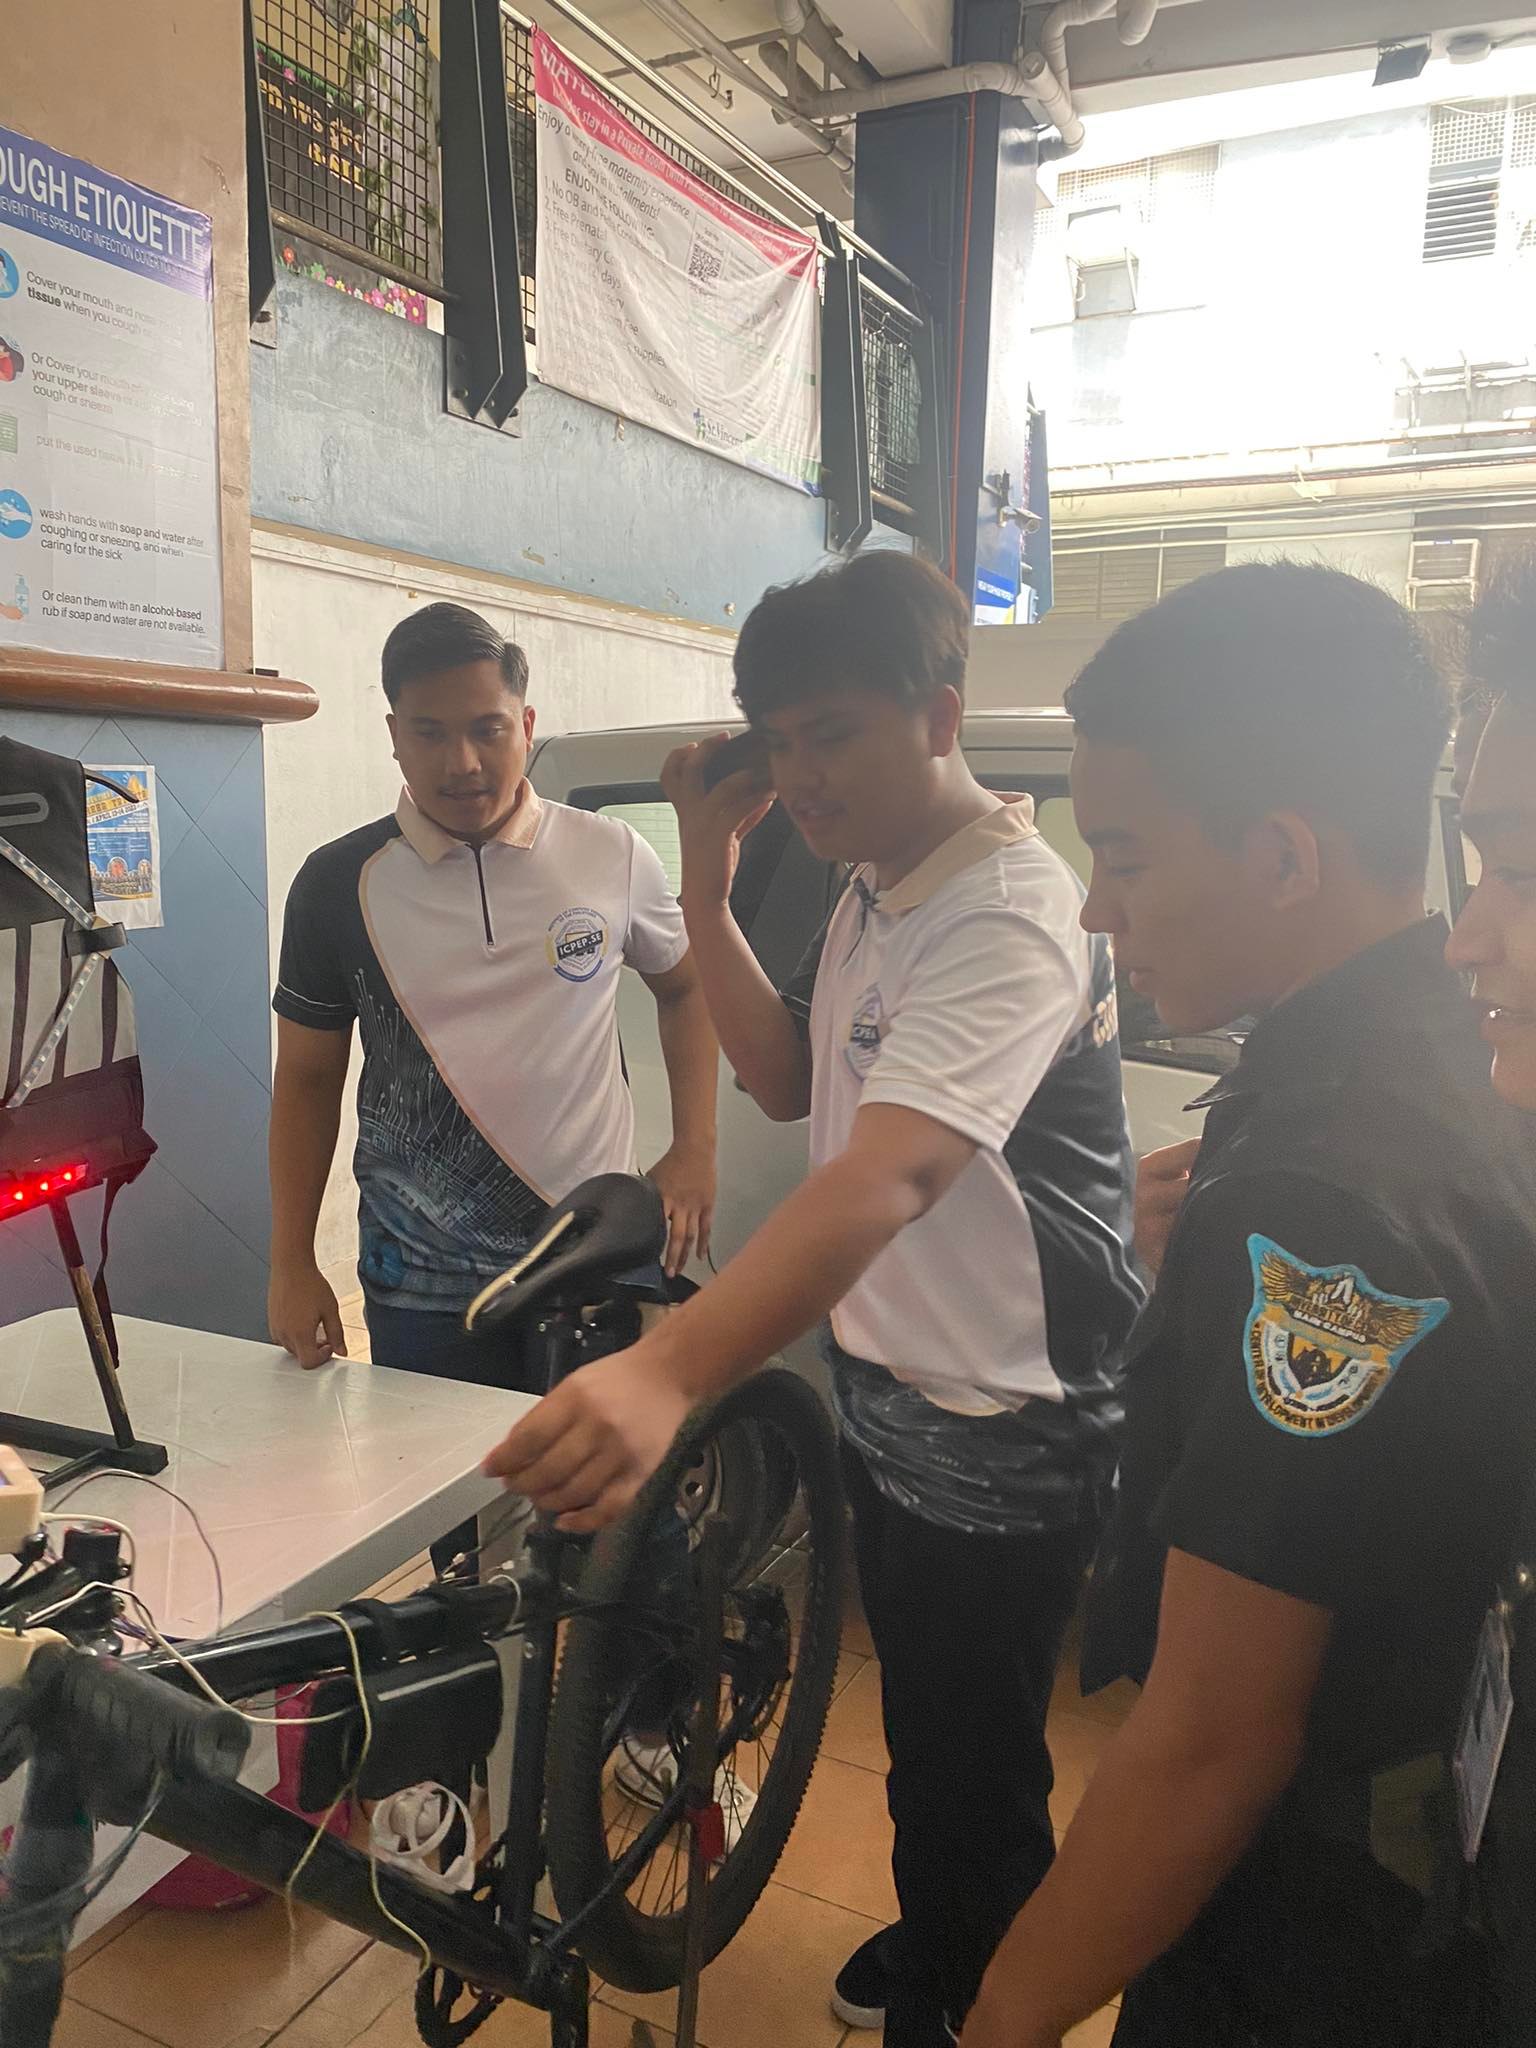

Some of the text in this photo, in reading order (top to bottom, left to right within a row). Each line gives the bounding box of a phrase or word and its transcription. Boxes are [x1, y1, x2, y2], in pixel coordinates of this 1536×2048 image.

[538, 104, 564, 134] Enjoy
[74, 175, 205, 271] ETIQUETTE
[27, 271, 57, 291] Cover
[58, 283, 81, 299] your
[82, 290, 114, 312] mouth
[27, 287, 62, 307] tissue
[64, 300, 91, 317] when
[92, 311, 111, 324] you
[31, 352, 44, 365] Or
[46, 356, 75, 374] Cover
[31, 369, 56, 384] your
[57, 375, 88, 393] upper
[33, 385, 66, 402] cough
[40, 508, 66, 522] wash
[68, 511, 97, 528] hands
[119, 523, 142, 537] soap
[144, 526, 160, 540] and
[40, 523, 87, 542] coughing
[88, 533, 98, 543] or
[41, 538, 123, 561] caring for the sick
[42, 590, 201, 621] Or clean them with an alcohol-based
[42, 605, 60, 617] rub
[68, 610, 92, 623] soap
[93, 612, 111, 624] and
[112, 615, 137, 627] water
[138, 618, 153, 629] are
[154, 619, 168, 631] not
[560, 933, 602, 955] ICPEP.SE
[1322, 1321, 1367, 1344] CAMPUS
